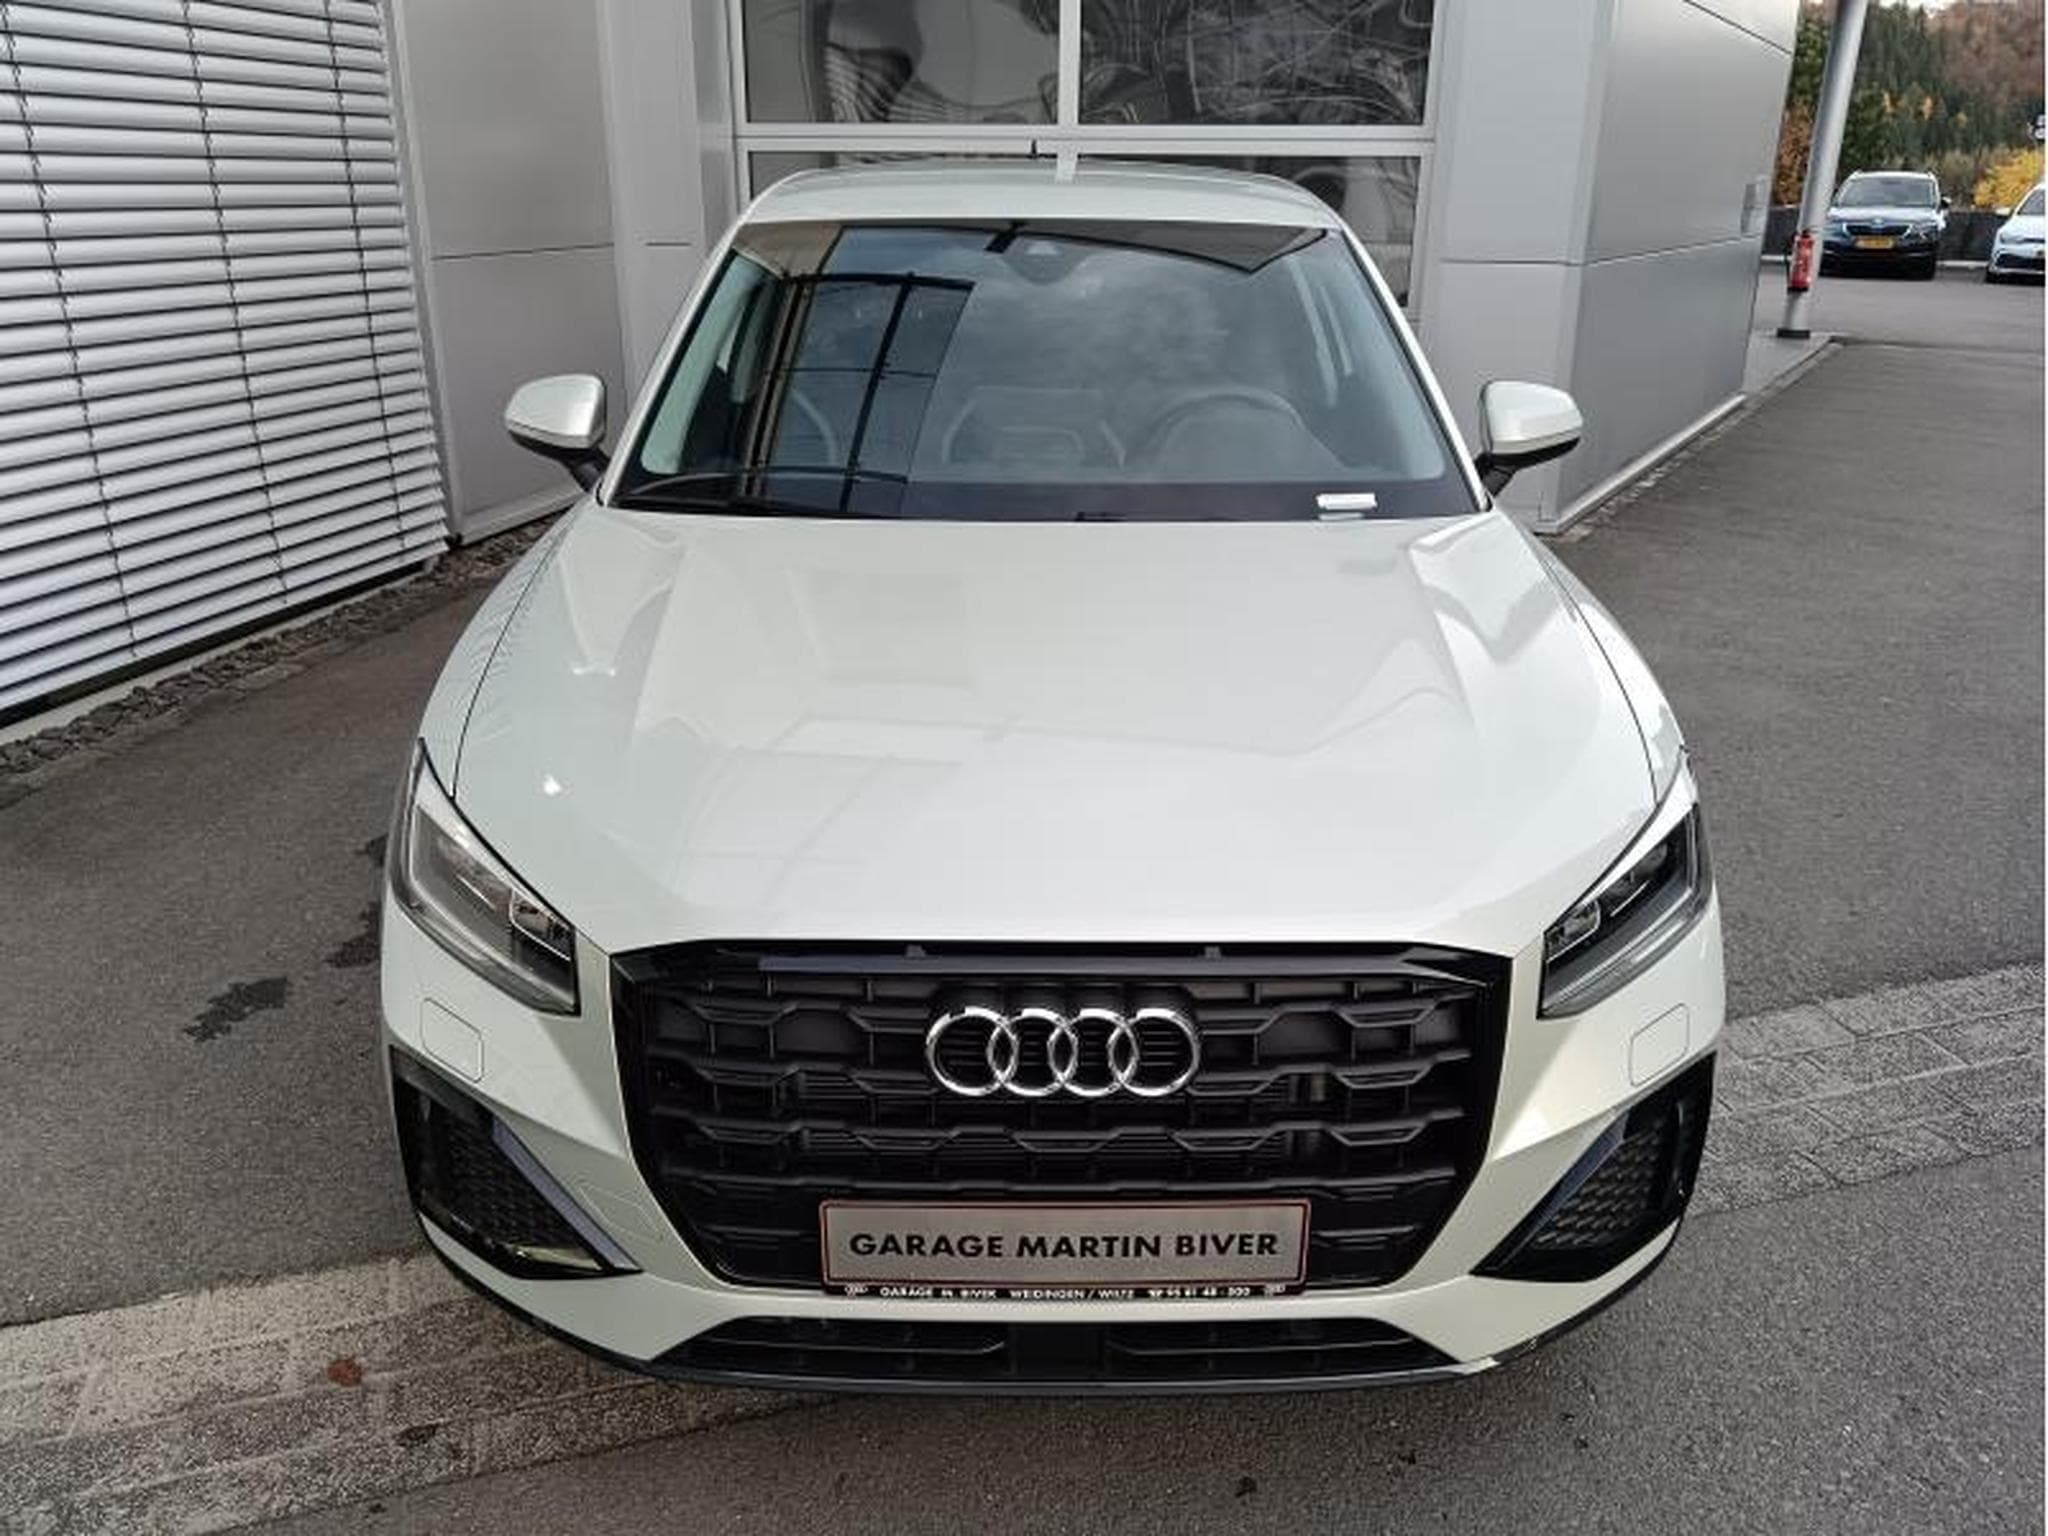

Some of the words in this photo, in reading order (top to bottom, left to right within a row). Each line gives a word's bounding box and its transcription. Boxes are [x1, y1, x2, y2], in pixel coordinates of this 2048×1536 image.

[850, 1233, 1004, 1257] GARAGE
[1017, 1234, 1162, 1257] MARTIN
[1177, 1233, 1278, 1256] BIVER
